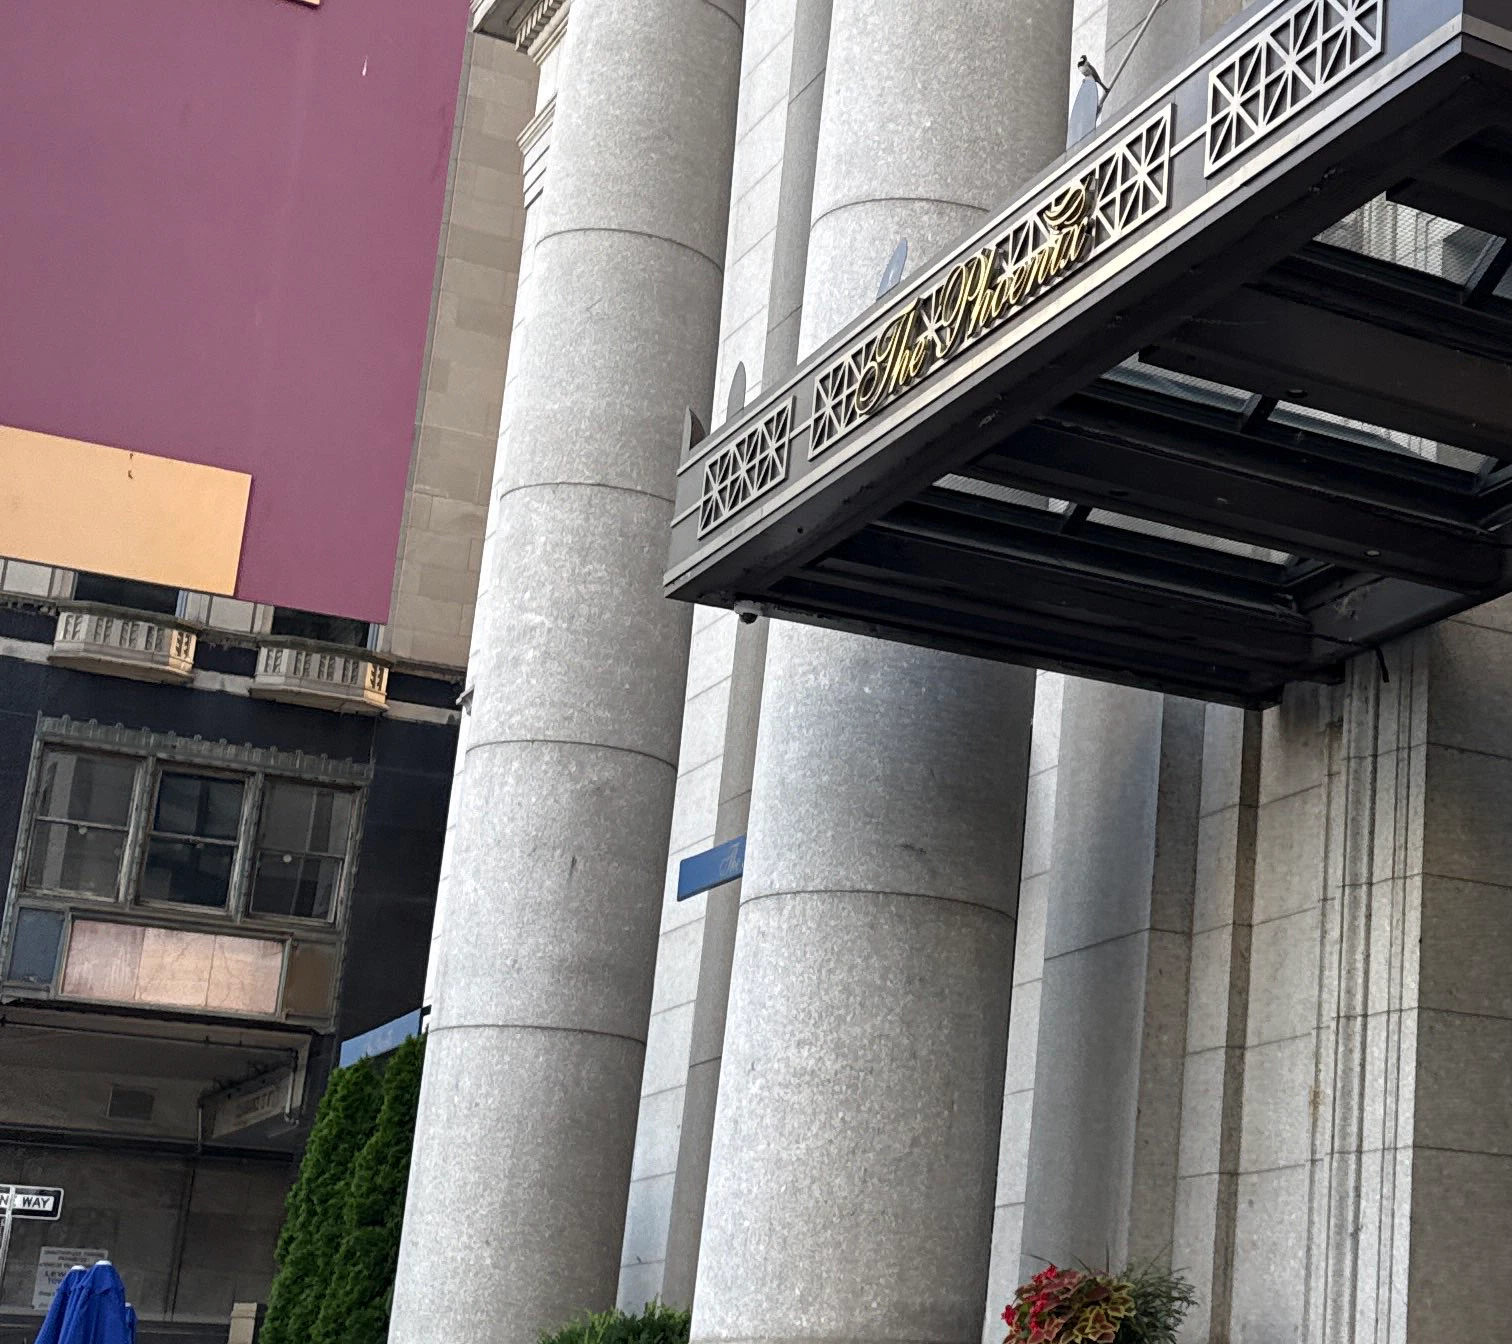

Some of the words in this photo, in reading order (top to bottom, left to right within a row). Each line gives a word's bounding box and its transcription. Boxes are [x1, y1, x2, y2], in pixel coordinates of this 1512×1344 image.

[855, 296, 934, 416] The
[936, 181, 1095, 358] Phoenix
[22, 1196, 50, 1209] WAY
